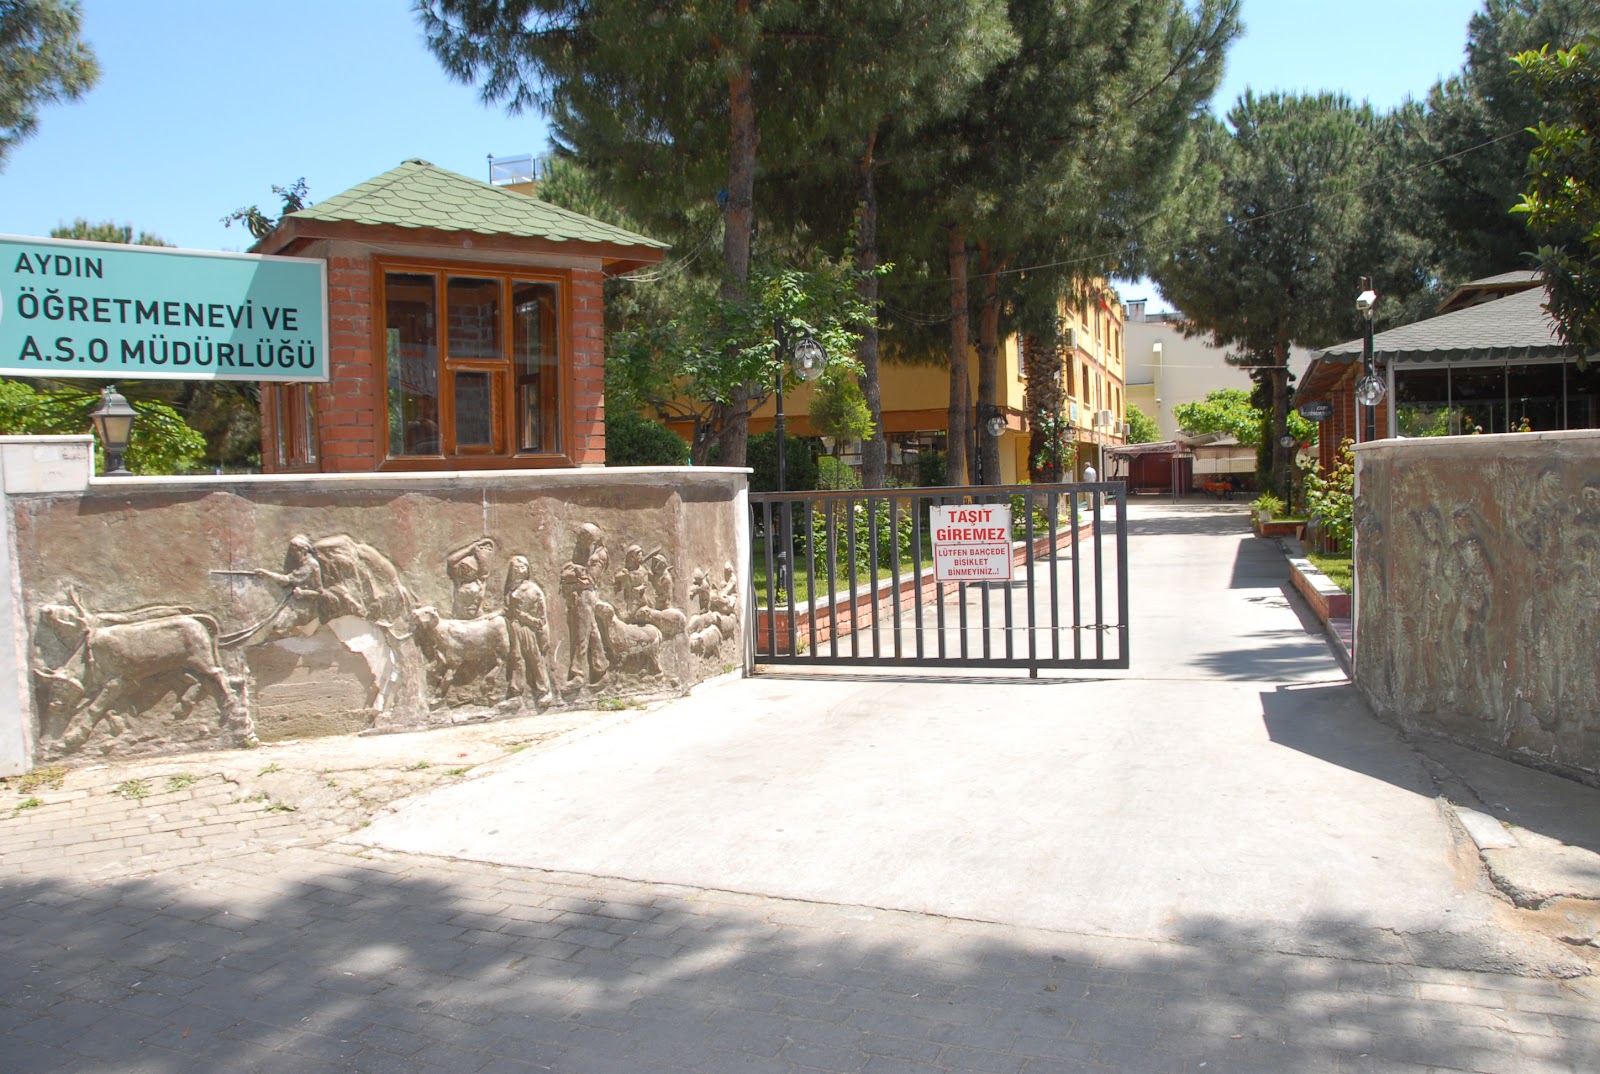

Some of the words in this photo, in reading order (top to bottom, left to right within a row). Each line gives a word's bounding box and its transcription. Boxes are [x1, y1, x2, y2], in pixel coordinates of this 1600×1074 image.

[14, 252, 104, 279] AYDIN
[17, 287, 254, 330] ÖĞRETMENEVİ
[261, 306, 299, 332] VE
[18, 335, 109, 364] A.S.O
[120, 334, 316, 369] MÜDÜRLÜĞÜ
[948, 510, 992, 525] TAŞIT
[936, 526, 1005, 541] GİREMEZ
[938, 548, 968, 557] LÜTFEN
[969, 548, 1005, 557] BAHÇEDE
